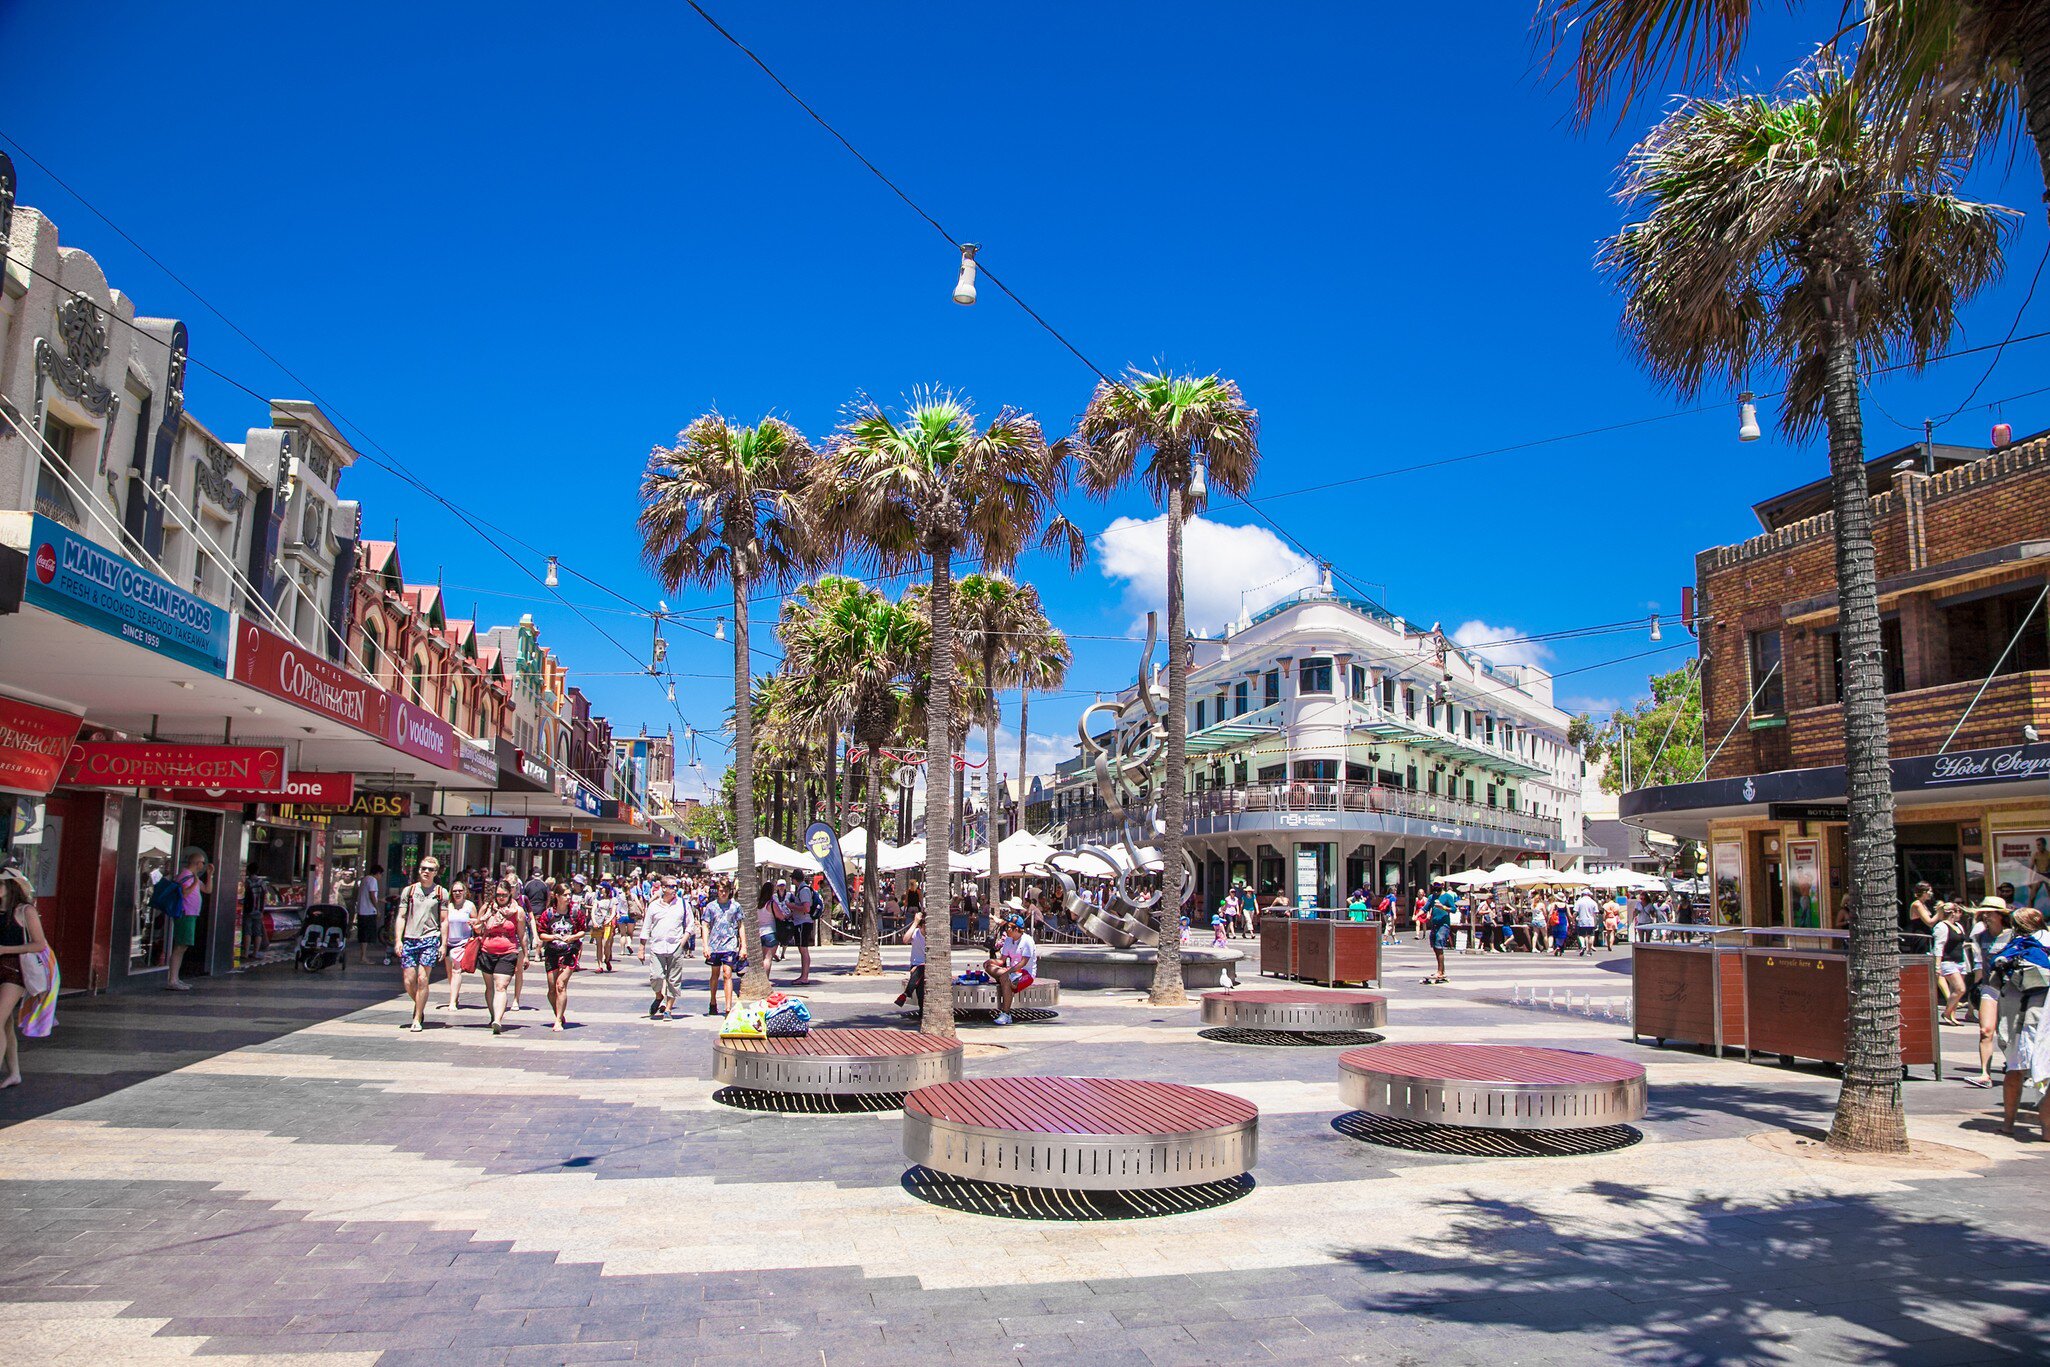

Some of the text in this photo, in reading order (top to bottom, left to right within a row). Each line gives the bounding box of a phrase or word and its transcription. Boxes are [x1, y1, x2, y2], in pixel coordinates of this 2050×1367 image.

[63, 538, 212, 634] MANLY OCEAN FOODS
[60, 575, 211, 651] FRESH & COOKED SEAFOOD TAKEAWAY
[122, 623, 160, 648] SINCE 1959
[279, 650, 367, 724] COPENHAGEN
[0, 726, 74, 758] PENHAGEN
[409, 718, 444, 755] vodafone
[87, 753, 251, 778] COPENHAGEN
[145, 751, 194, 759] ROYAL
[1932, 750, 2050, 778] Hotel Steyn
[0, 762, 49, 776] RESH DAILY
[117, 778, 221, 787] ICE CREAM
[472, 825, 503, 833] CURL
[514, 841, 564, 849] SEAFOOD
